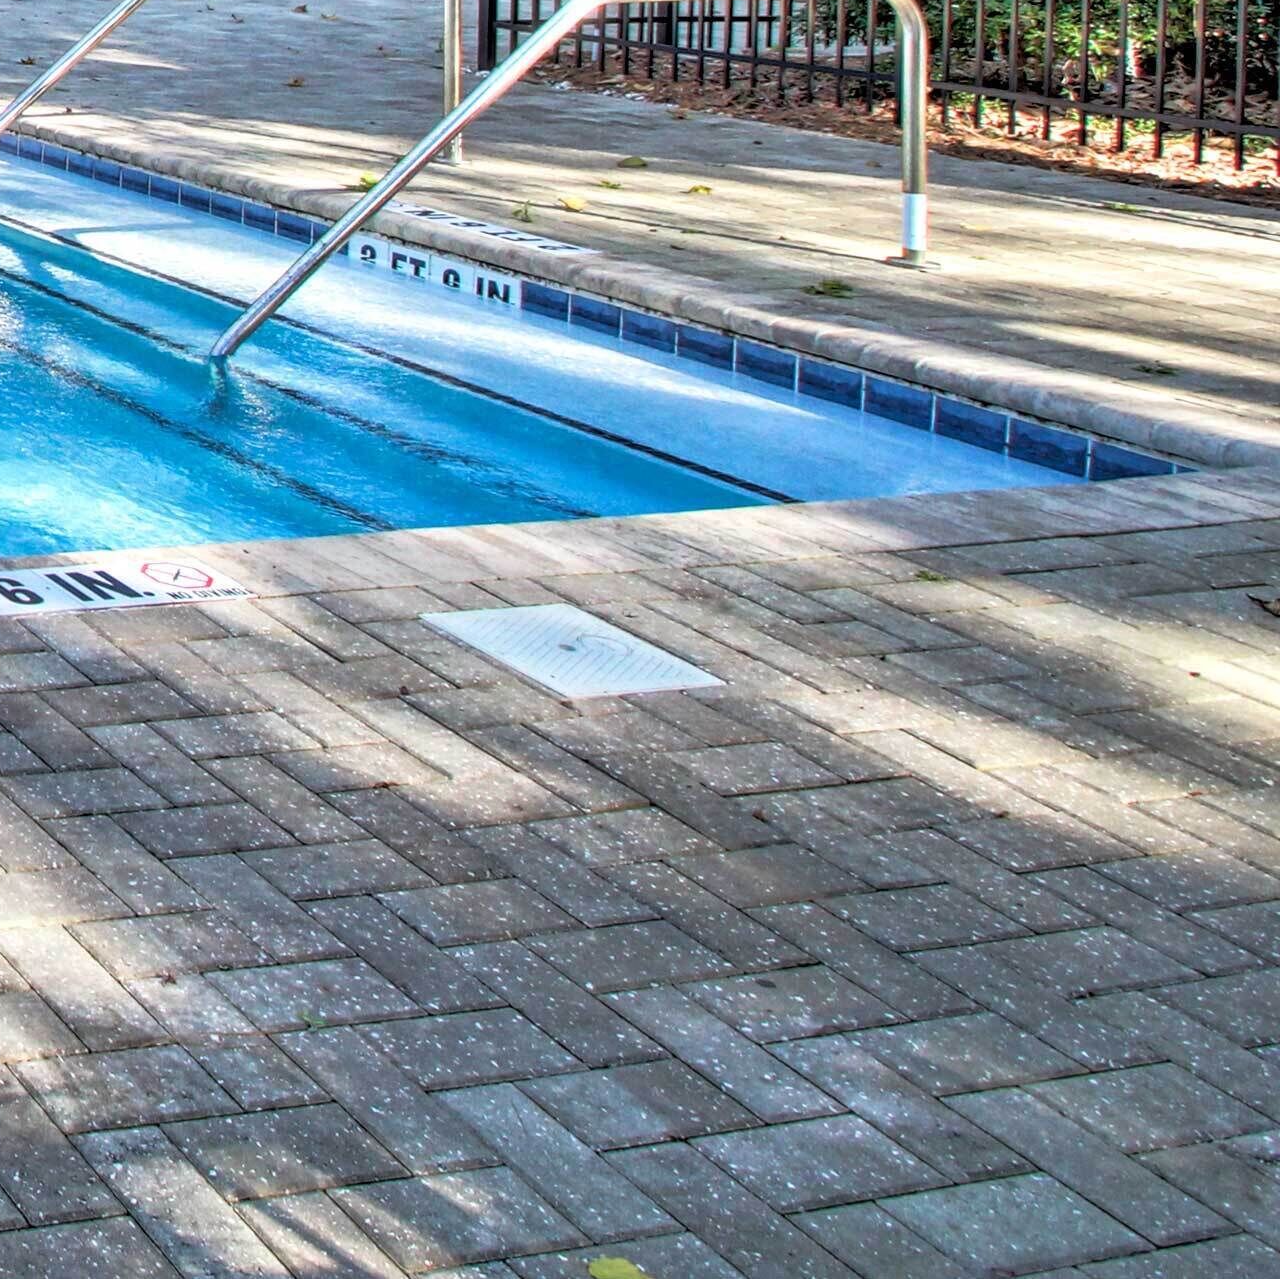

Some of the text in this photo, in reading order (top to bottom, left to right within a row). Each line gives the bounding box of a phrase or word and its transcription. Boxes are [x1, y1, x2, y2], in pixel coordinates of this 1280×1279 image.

[44, 570, 156, 602] IN.
[166, 587, 248, 600] NO DIVING
